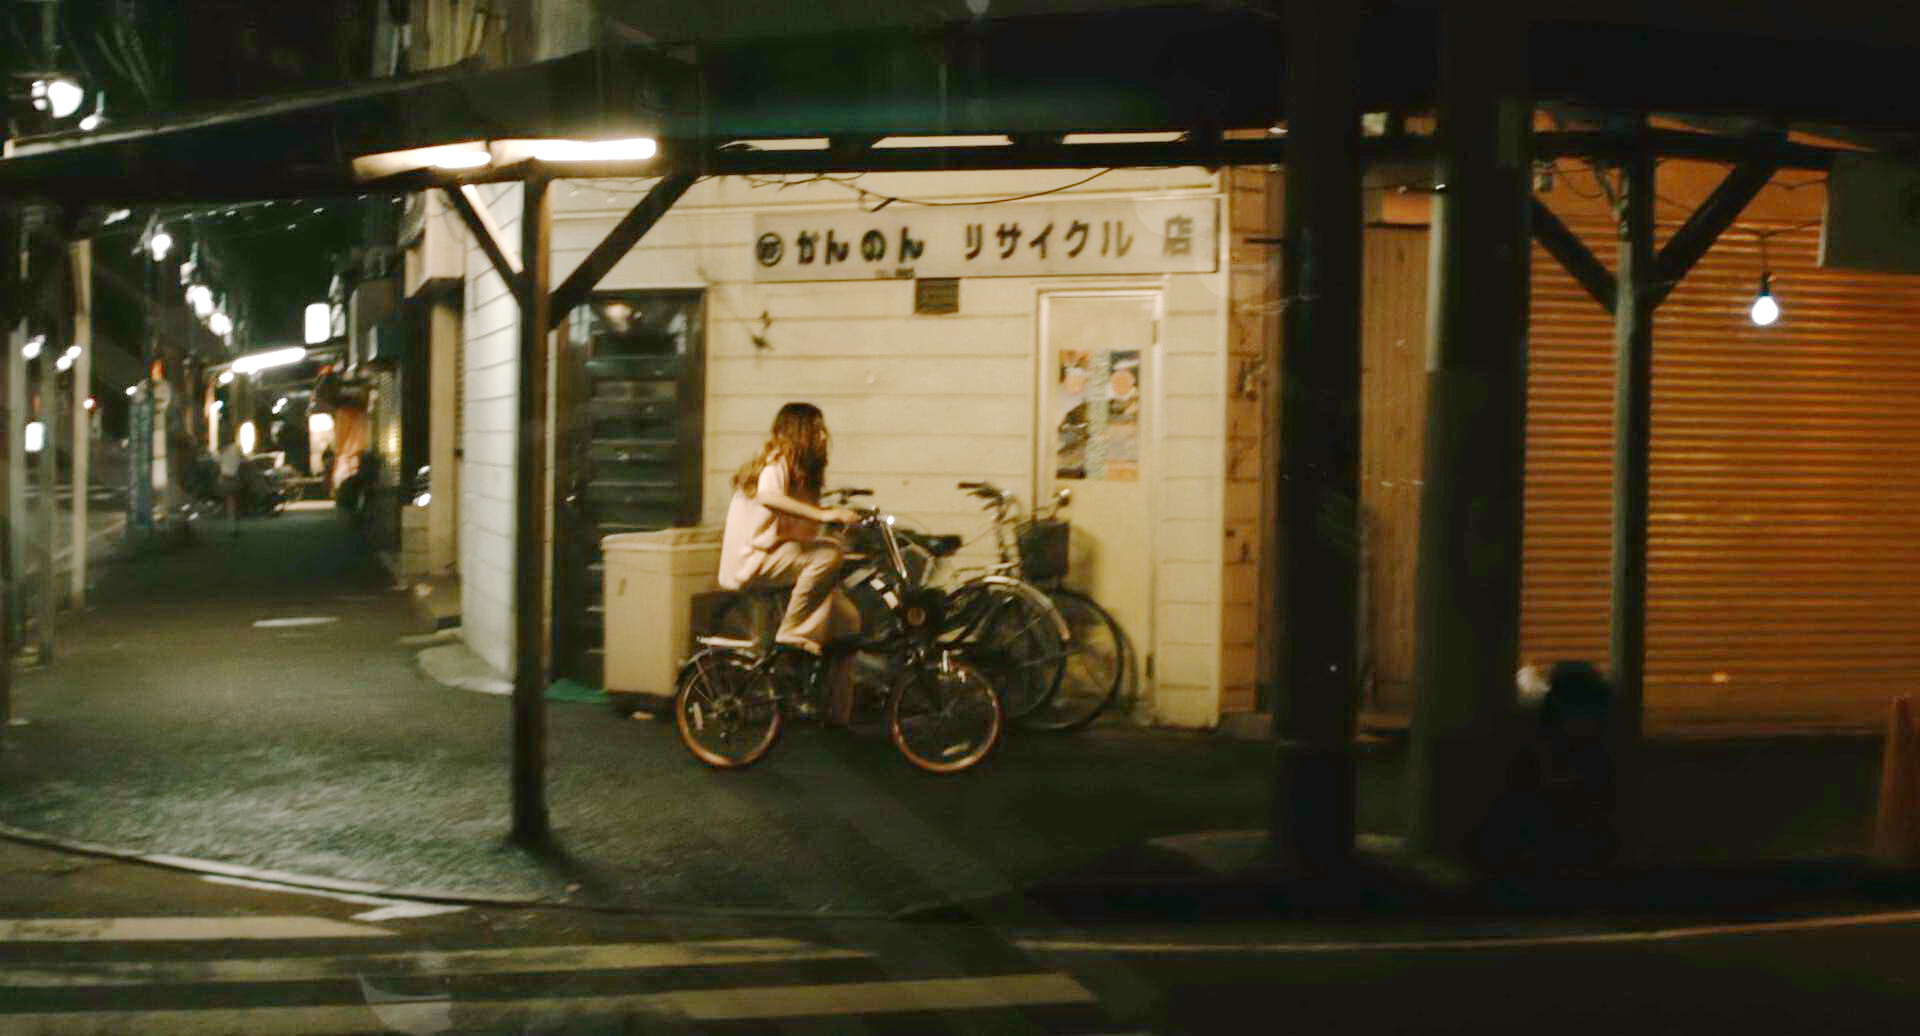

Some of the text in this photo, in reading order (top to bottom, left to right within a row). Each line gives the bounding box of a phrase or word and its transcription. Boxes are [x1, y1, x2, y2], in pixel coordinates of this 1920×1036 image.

[966, 220, 1133, 260] リサイクル
[1164, 214, 1194, 256] 店
